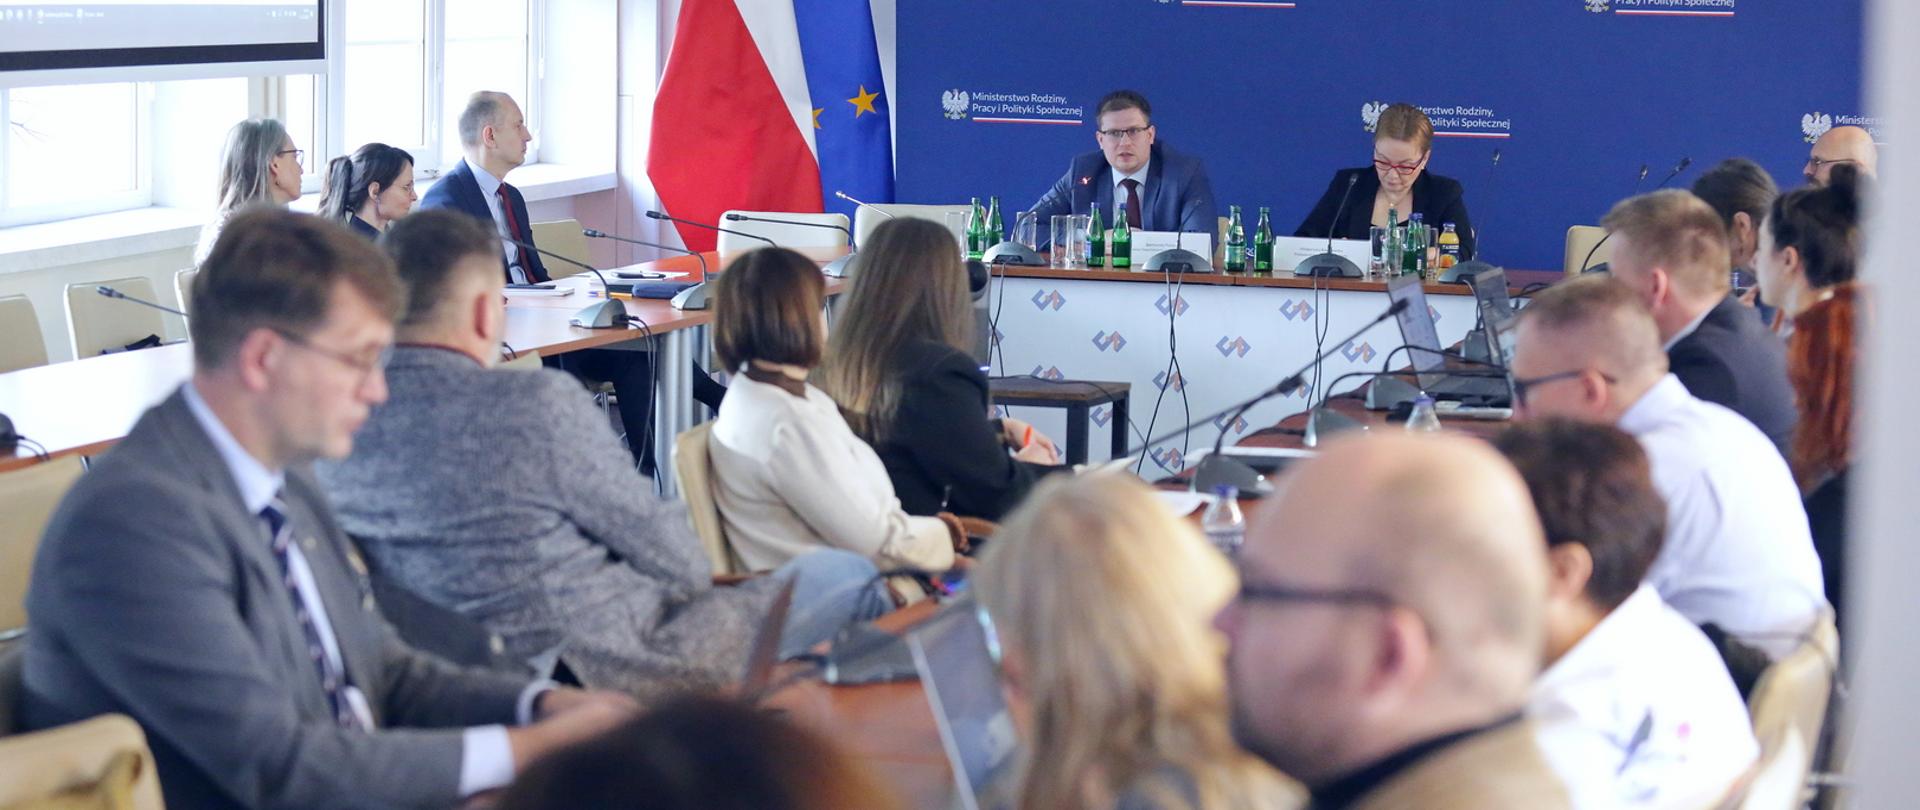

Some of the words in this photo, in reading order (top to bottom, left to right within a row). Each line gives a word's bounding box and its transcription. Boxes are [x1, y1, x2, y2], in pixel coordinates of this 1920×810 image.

[972, 92, 1030, 102] Ministerstwo
[1031, 93, 1068, 106] Rodziny,
[972, 103, 997, 113] Pracy
[1002, 104, 1035, 115] Polityki
[1036, 105, 1083, 117] Społecznej
[1456, 106, 1494, 118] Rodziny,
[1461, 118, 1511, 130] Społecznej
